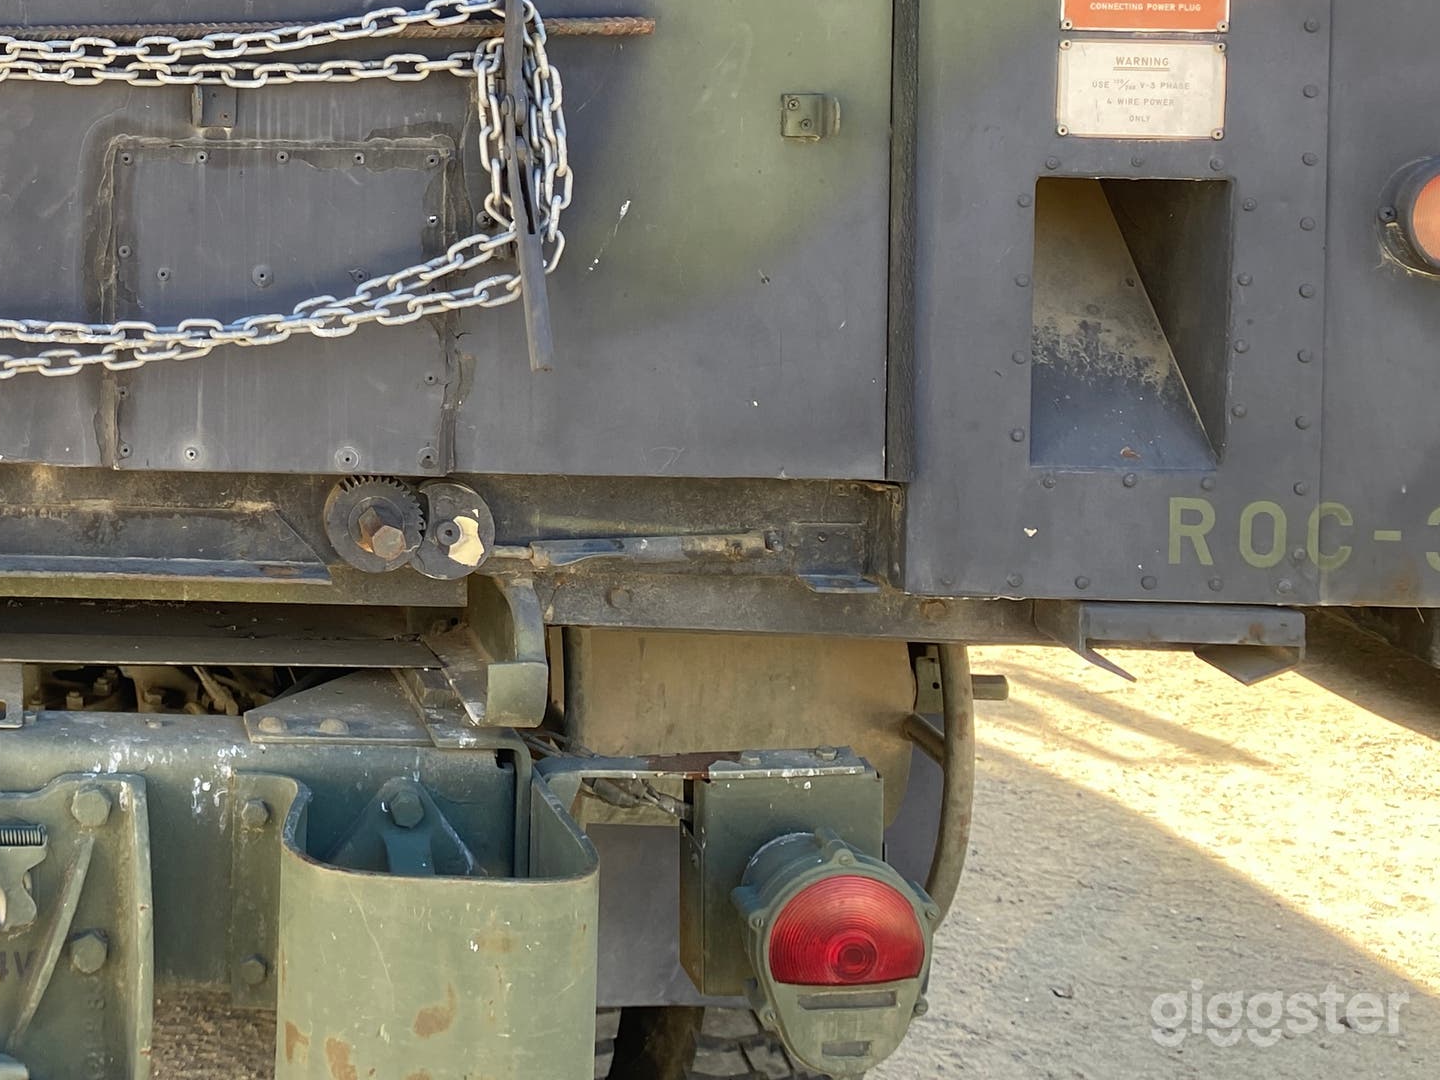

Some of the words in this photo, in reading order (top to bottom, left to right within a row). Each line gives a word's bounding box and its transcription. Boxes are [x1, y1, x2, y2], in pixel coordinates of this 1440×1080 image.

[1089, 2, 1143, 11] CONNECTING
[1146, 3, 1176, 12] POWER
[1178, 3, 1201, 12] PLUG
[1116, 56, 1169, 66] WARNING
[1091, 80, 1110, 89] USE
[1160, 81, 1191, 90] PHASE
[1117, 98, 1140, 106] WIRE
[1143, 98, 1176, 107] POWER
[1129, 115, 1151, 123] ONLY
